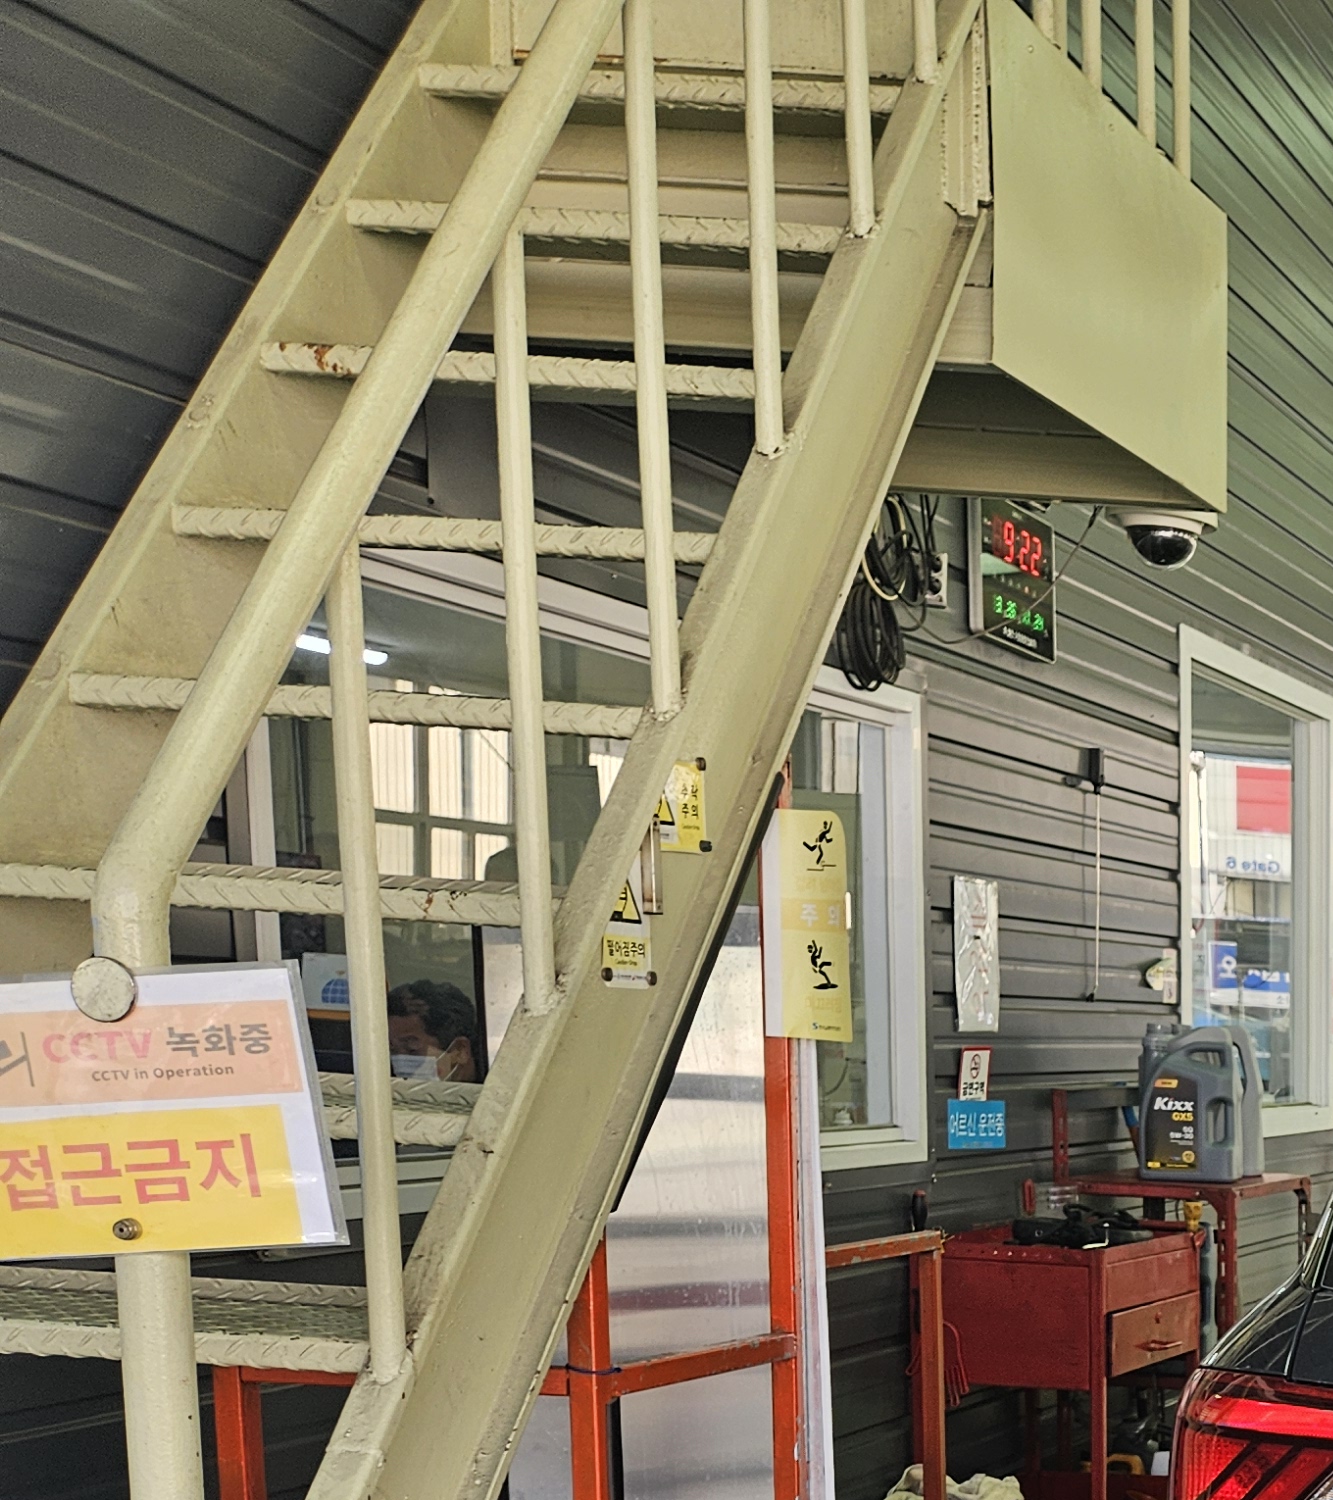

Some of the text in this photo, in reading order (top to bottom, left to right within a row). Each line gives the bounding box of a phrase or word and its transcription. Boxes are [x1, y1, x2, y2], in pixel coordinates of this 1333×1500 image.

[42, 1023, 272, 1063] CCTV 녹화중
[91, 1064, 235, 1082] CCTV in Operation
[1153, 1096, 1194, 1111] Kixx
[950, 1111, 1004, 1137] 어르신 운전중
[0, 1133, 262, 1212] 접근금지
